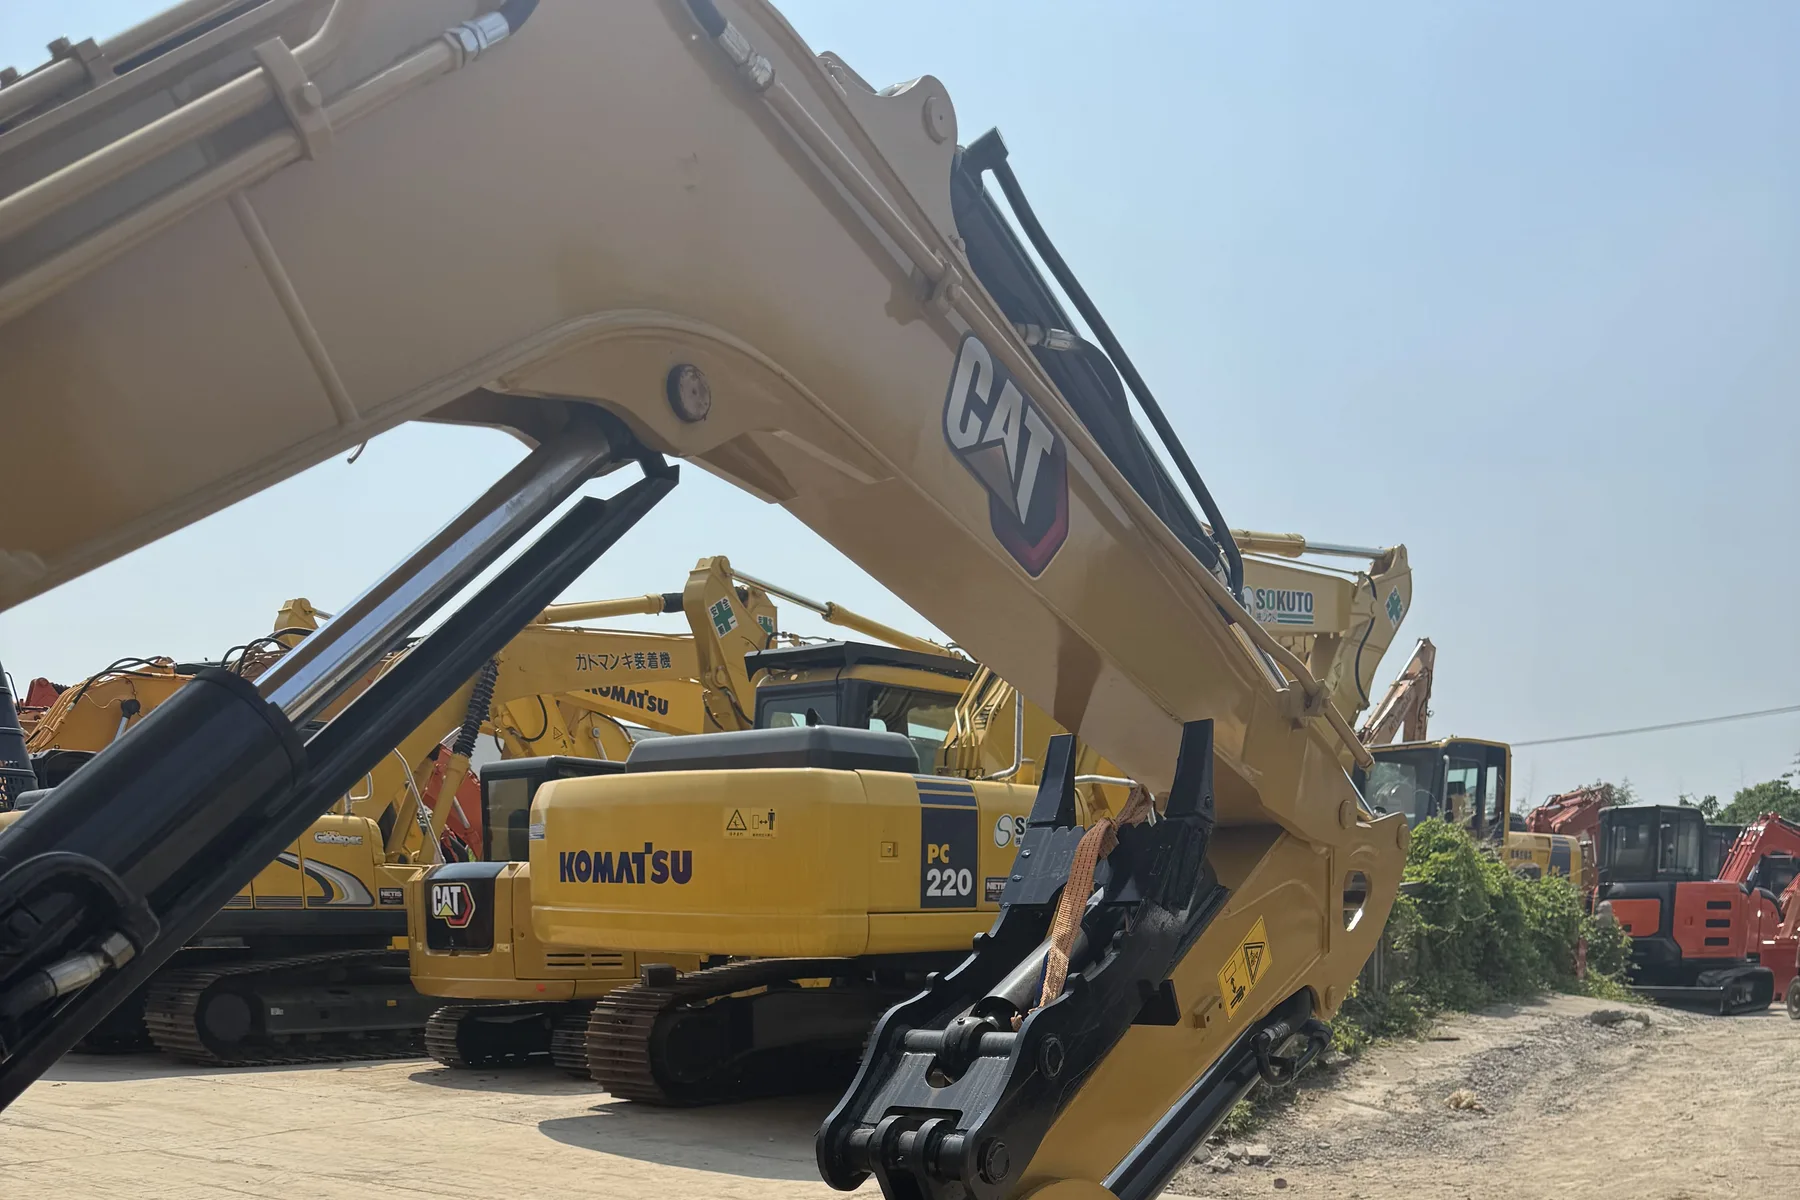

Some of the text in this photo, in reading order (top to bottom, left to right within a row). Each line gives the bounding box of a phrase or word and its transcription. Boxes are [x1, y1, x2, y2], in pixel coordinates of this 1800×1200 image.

[946, 336, 1055, 525] CAT
[1256, 588, 1313, 613] SOKUTO
[559, 842, 693, 885] KOMATSU
[927, 843, 950, 864] PC
[926, 868, 973, 897] 220
[432, 885, 462, 916] CAT
